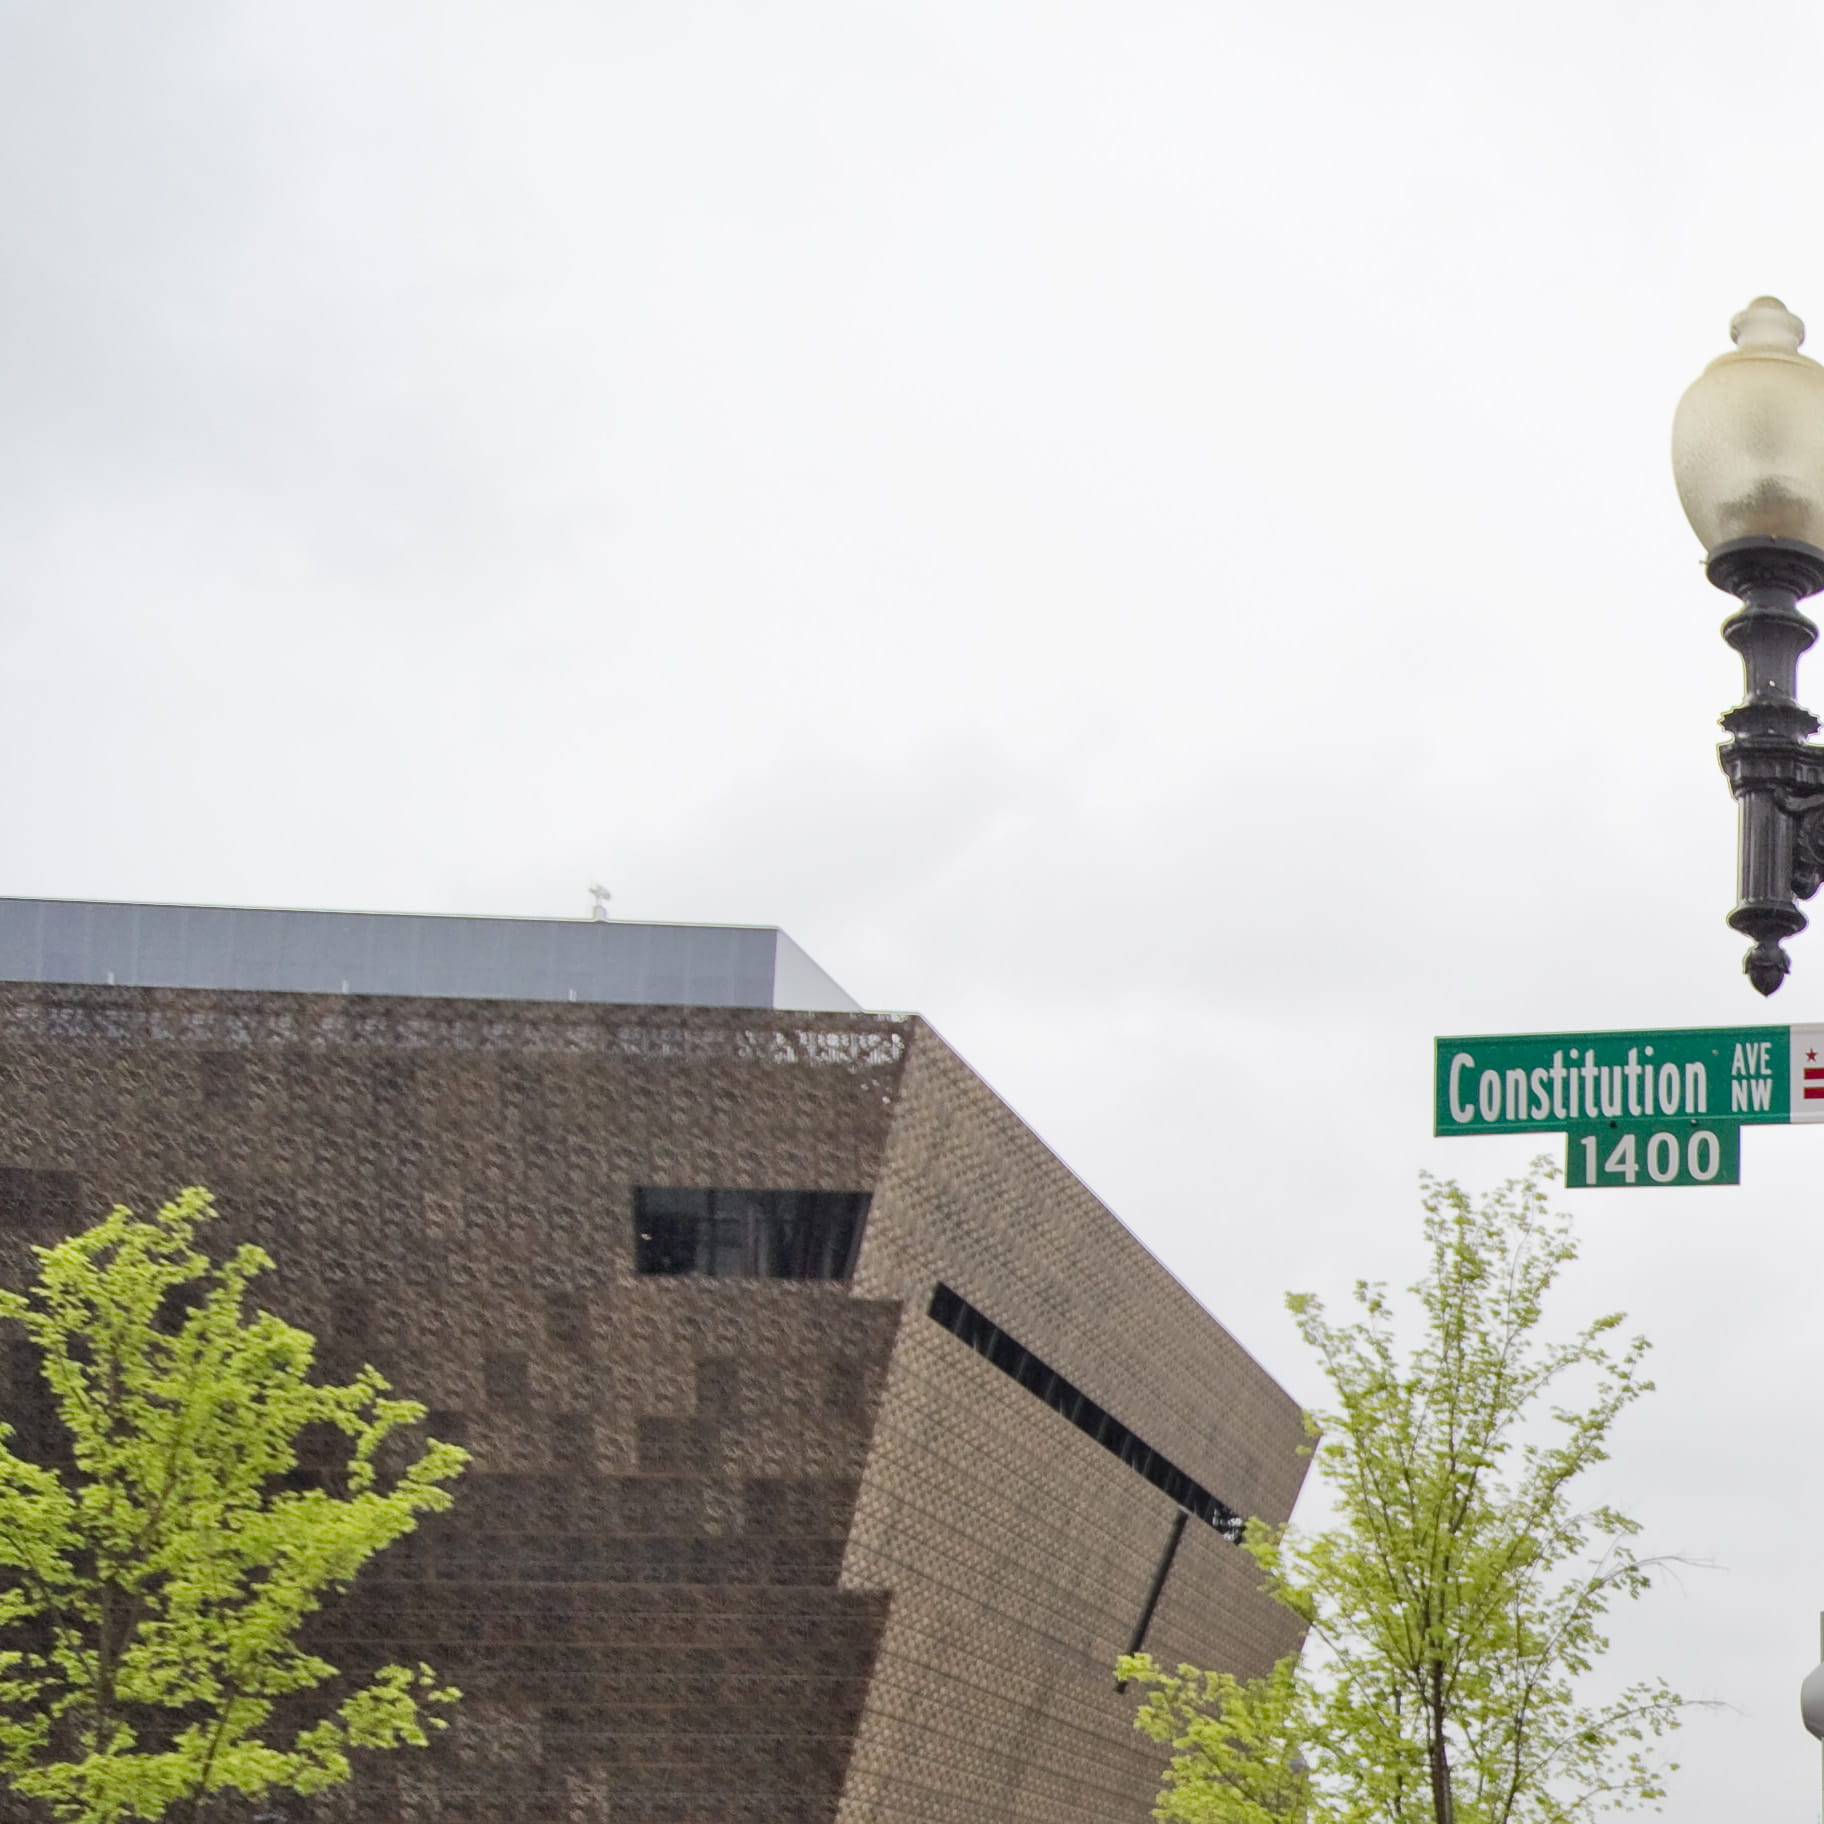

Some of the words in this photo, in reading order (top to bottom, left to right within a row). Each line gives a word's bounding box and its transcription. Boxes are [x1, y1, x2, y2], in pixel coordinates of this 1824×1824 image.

[1448, 1045, 1707, 1123] Constitution
[1731, 1041, 1772, 1076] AVE
[1731, 1078, 1773, 1113] NW
[1579, 1129, 1721, 1186] 1400
